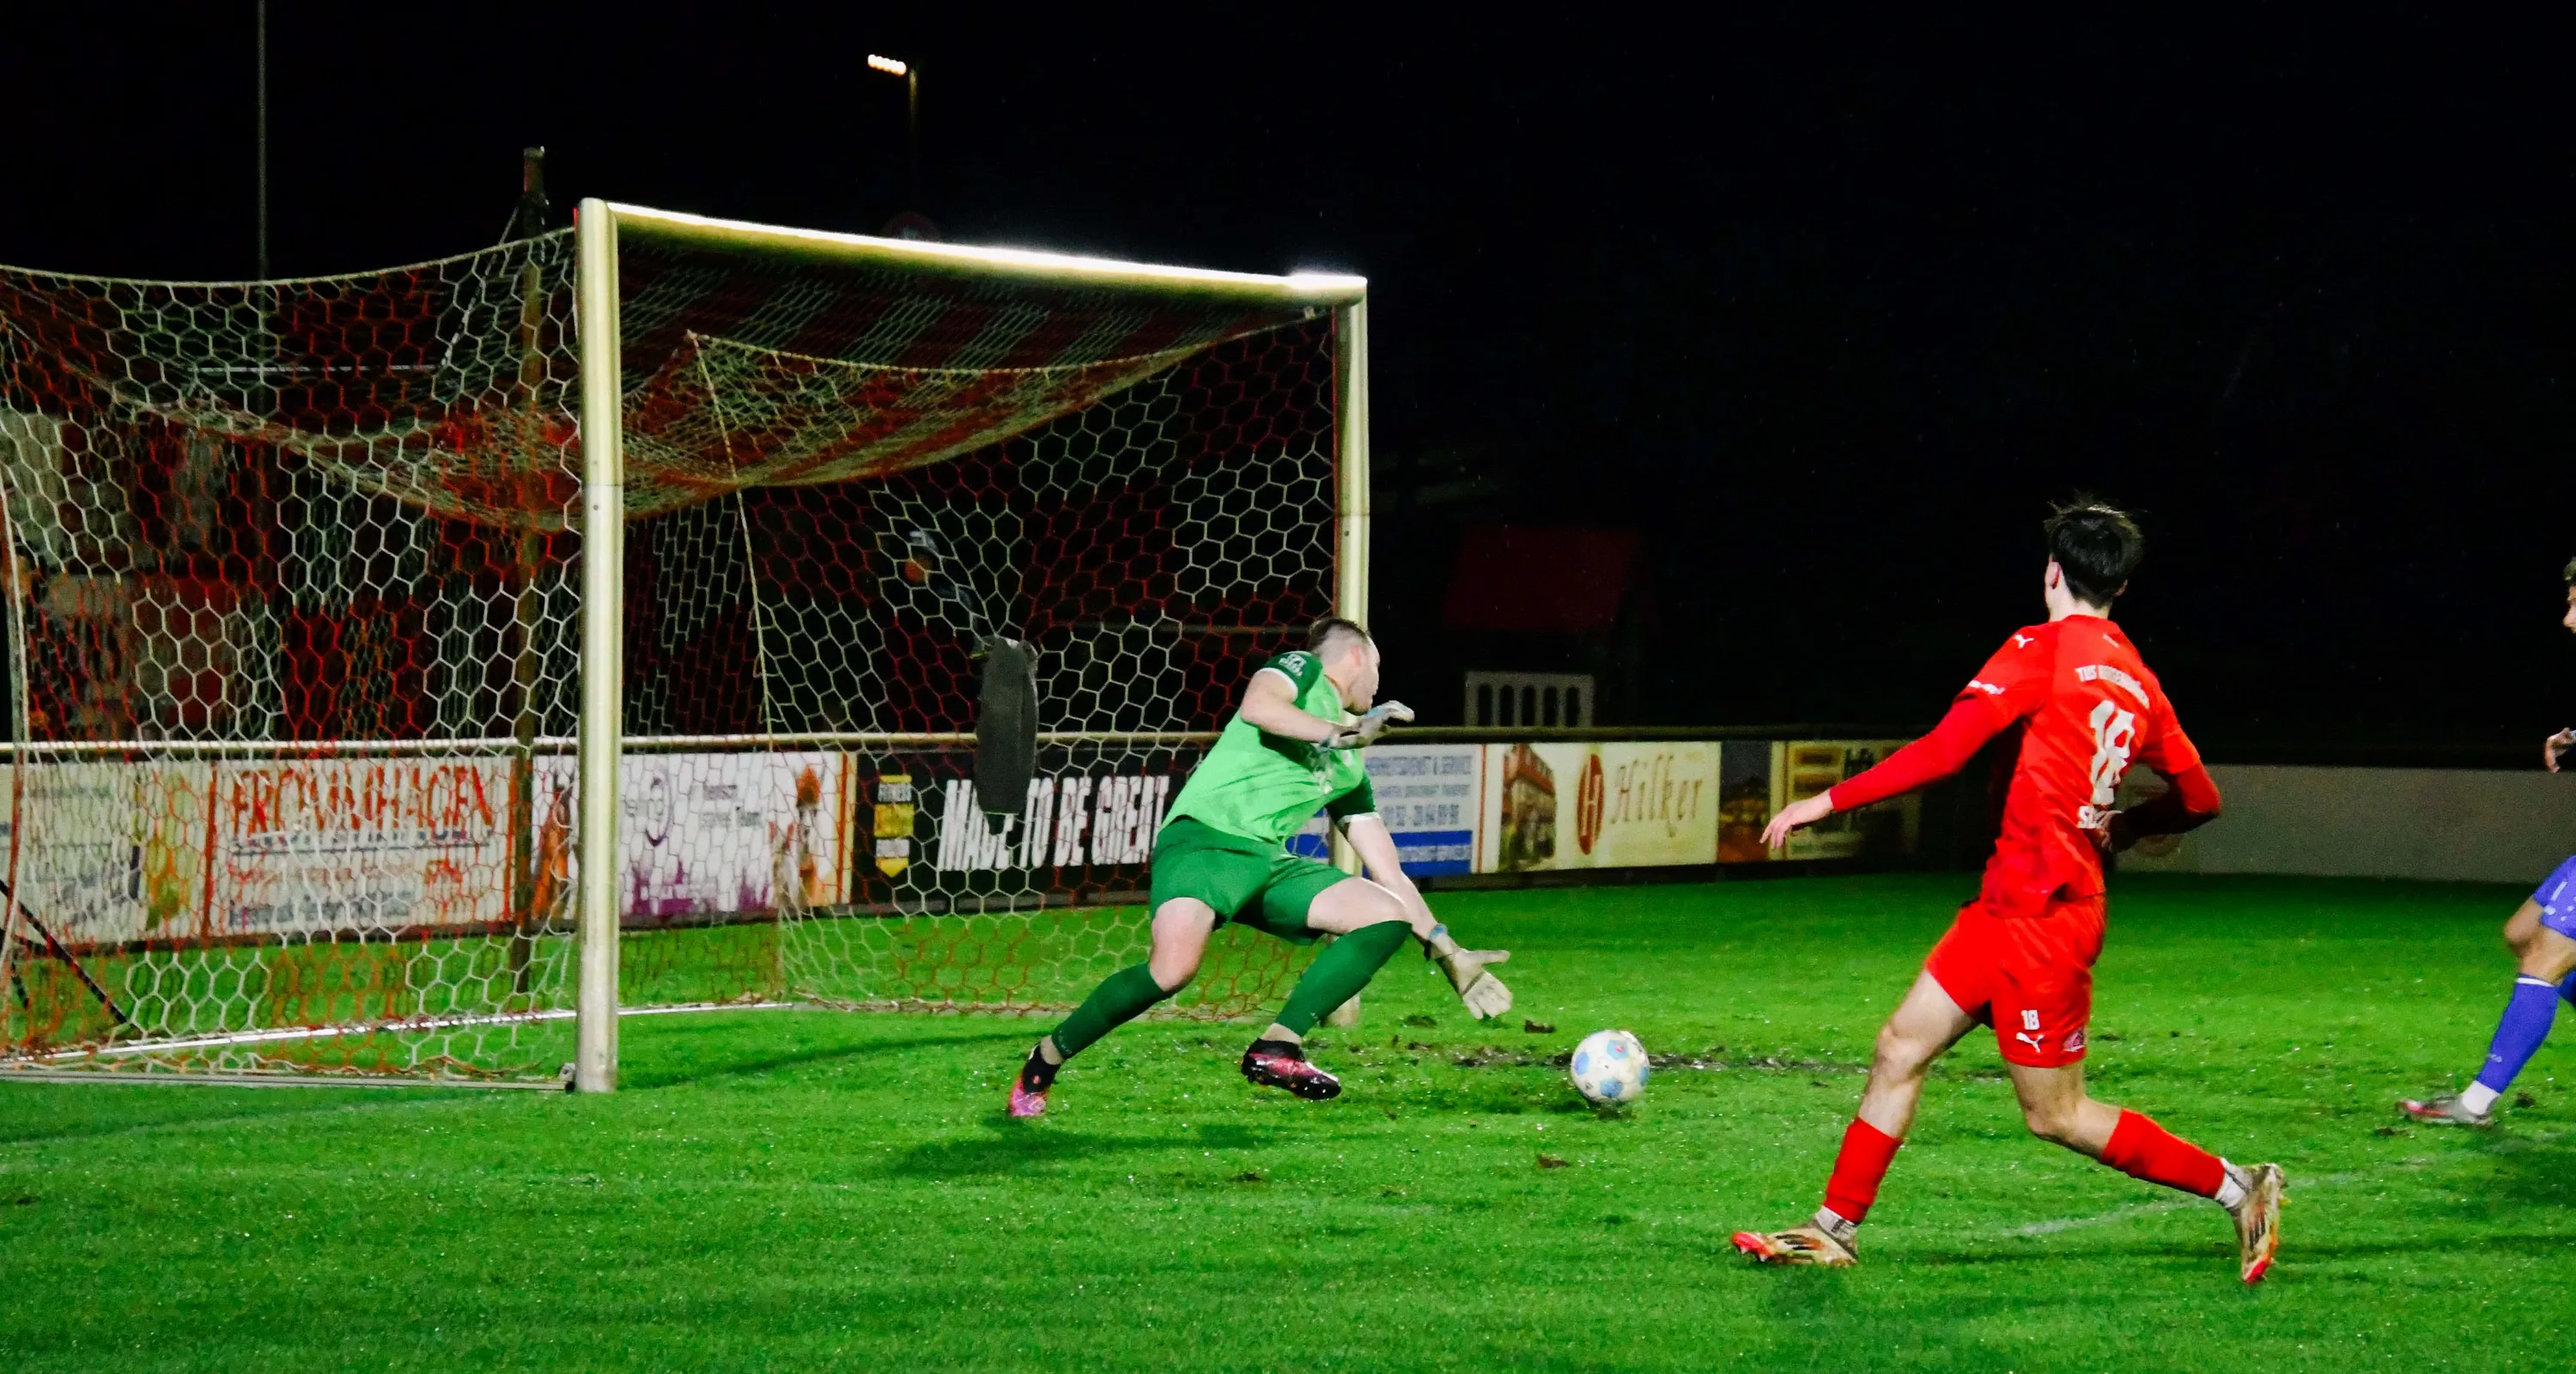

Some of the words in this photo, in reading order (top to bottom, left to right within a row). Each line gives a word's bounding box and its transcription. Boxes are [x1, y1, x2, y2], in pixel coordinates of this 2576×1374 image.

[1610, 754, 1704, 838] Hilker
[2090, 699, 2136, 806] 18
[1019, 777, 1054, 868] TO
[1054, 776, 1092, 866] BE
[1091, 775, 1170, 866] GREAT
[2020, 1009, 2040, 1030] 18
